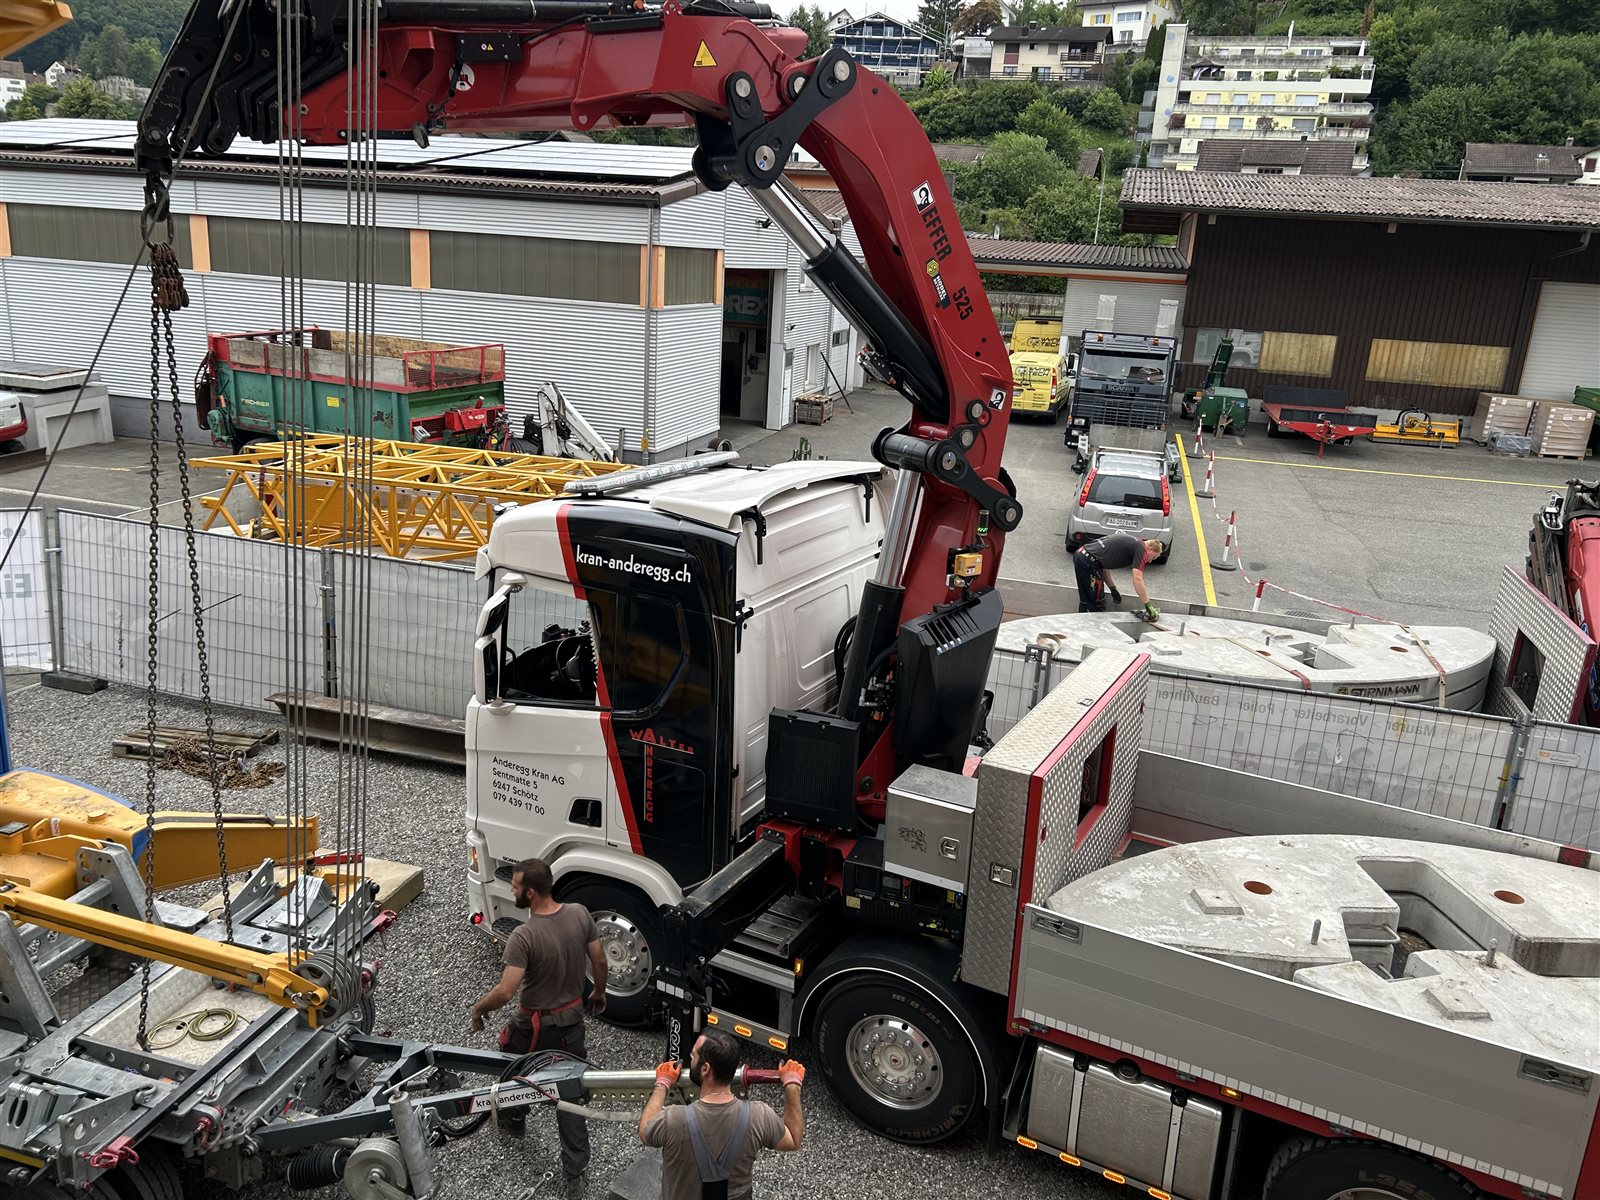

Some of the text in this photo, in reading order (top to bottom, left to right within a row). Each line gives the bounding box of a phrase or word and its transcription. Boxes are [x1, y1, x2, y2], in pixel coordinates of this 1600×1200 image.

[922, 206, 952, 261] EFFER
[952, 286, 974, 320] 525
[1107, 384, 1135, 392] SCANIA
[576, 544, 692, 583] kran-anderegg.ch
[1350, 684, 1420, 698] STIRNIMANN
[628, 727, 694, 754] WALTER
[492, 756, 565, 785] Anderegg Kran AG
[492, 767, 538, 789] Sentmatte 5
[492, 779, 539, 801] 6247 Schötz
[492, 791, 545, 815] 079 439 17 00
[475, 1087, 556, 1108] kraandereggh
[885, 1116, 957, 1139] MICHELIN
